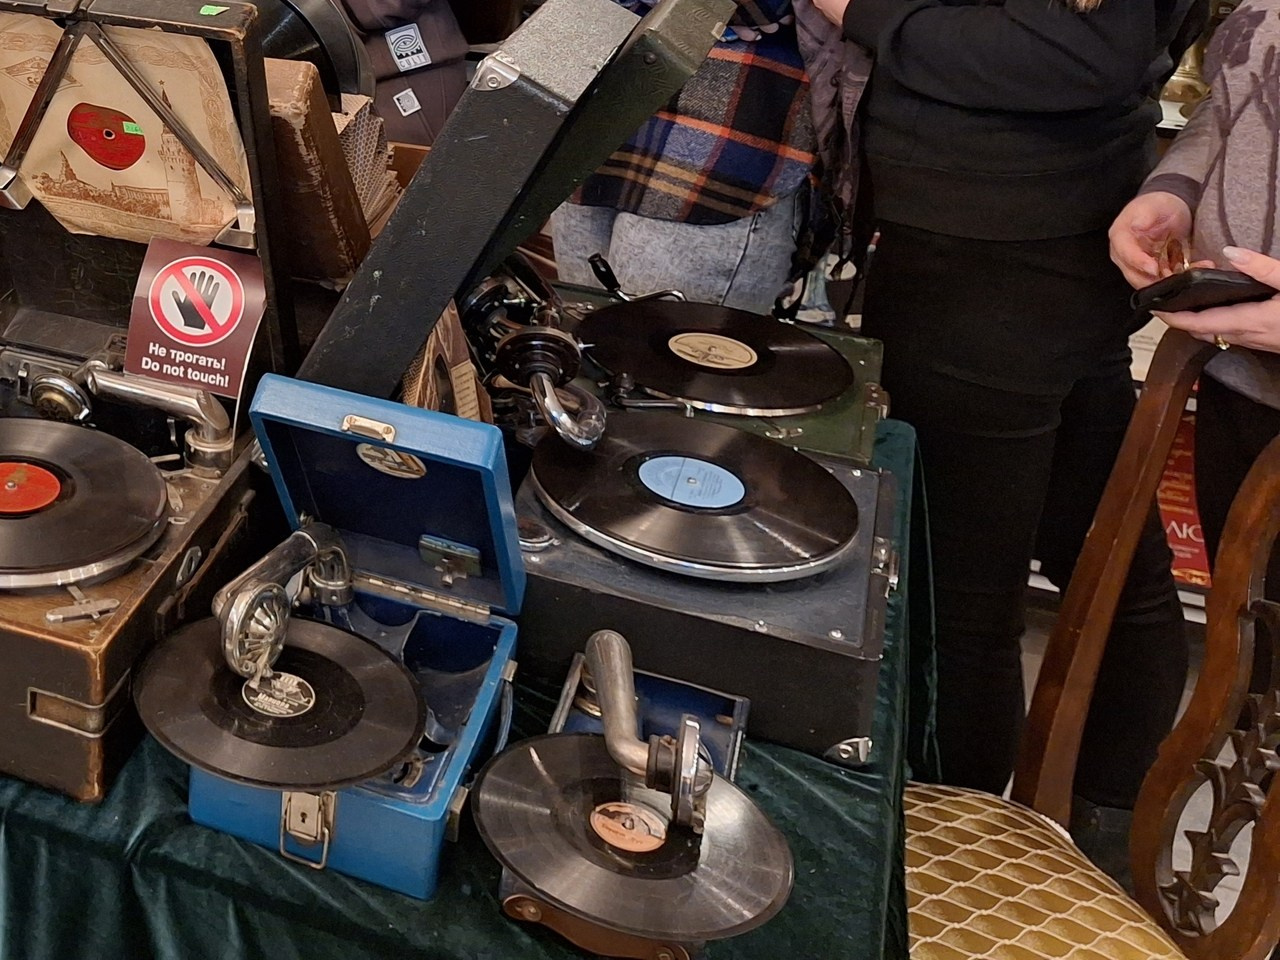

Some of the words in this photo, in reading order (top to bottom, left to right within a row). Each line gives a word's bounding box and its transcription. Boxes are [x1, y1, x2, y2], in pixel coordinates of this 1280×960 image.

[148, 342, 167, 357] Не
[169, 348, 226, 370] трогать!
[141, 357, 160, 371] Do
[162, 363, 185, 377] not
[187, 367, 229, 388] touch!
